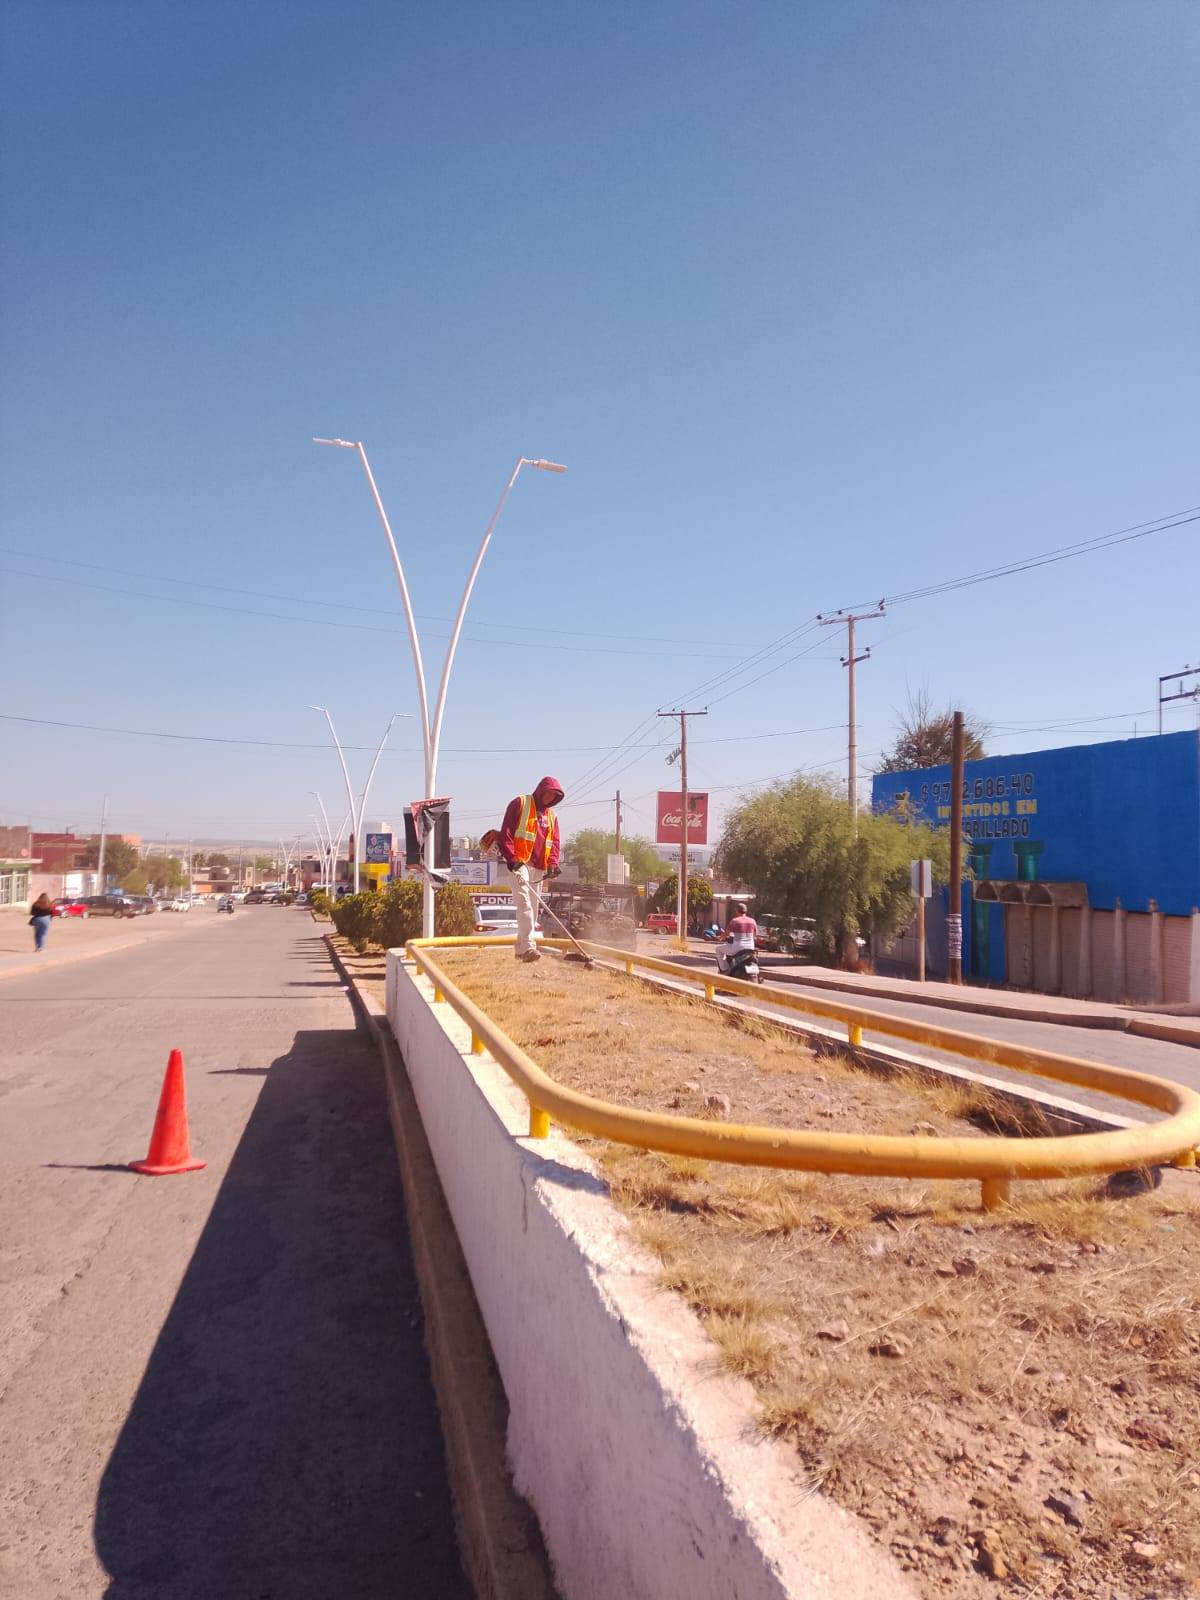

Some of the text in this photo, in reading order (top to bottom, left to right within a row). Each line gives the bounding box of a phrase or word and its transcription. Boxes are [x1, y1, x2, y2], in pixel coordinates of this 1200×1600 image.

[938, 799, 1037, 818] INRTIDOS EN
[662, 812, 704, 828] Cocaola
